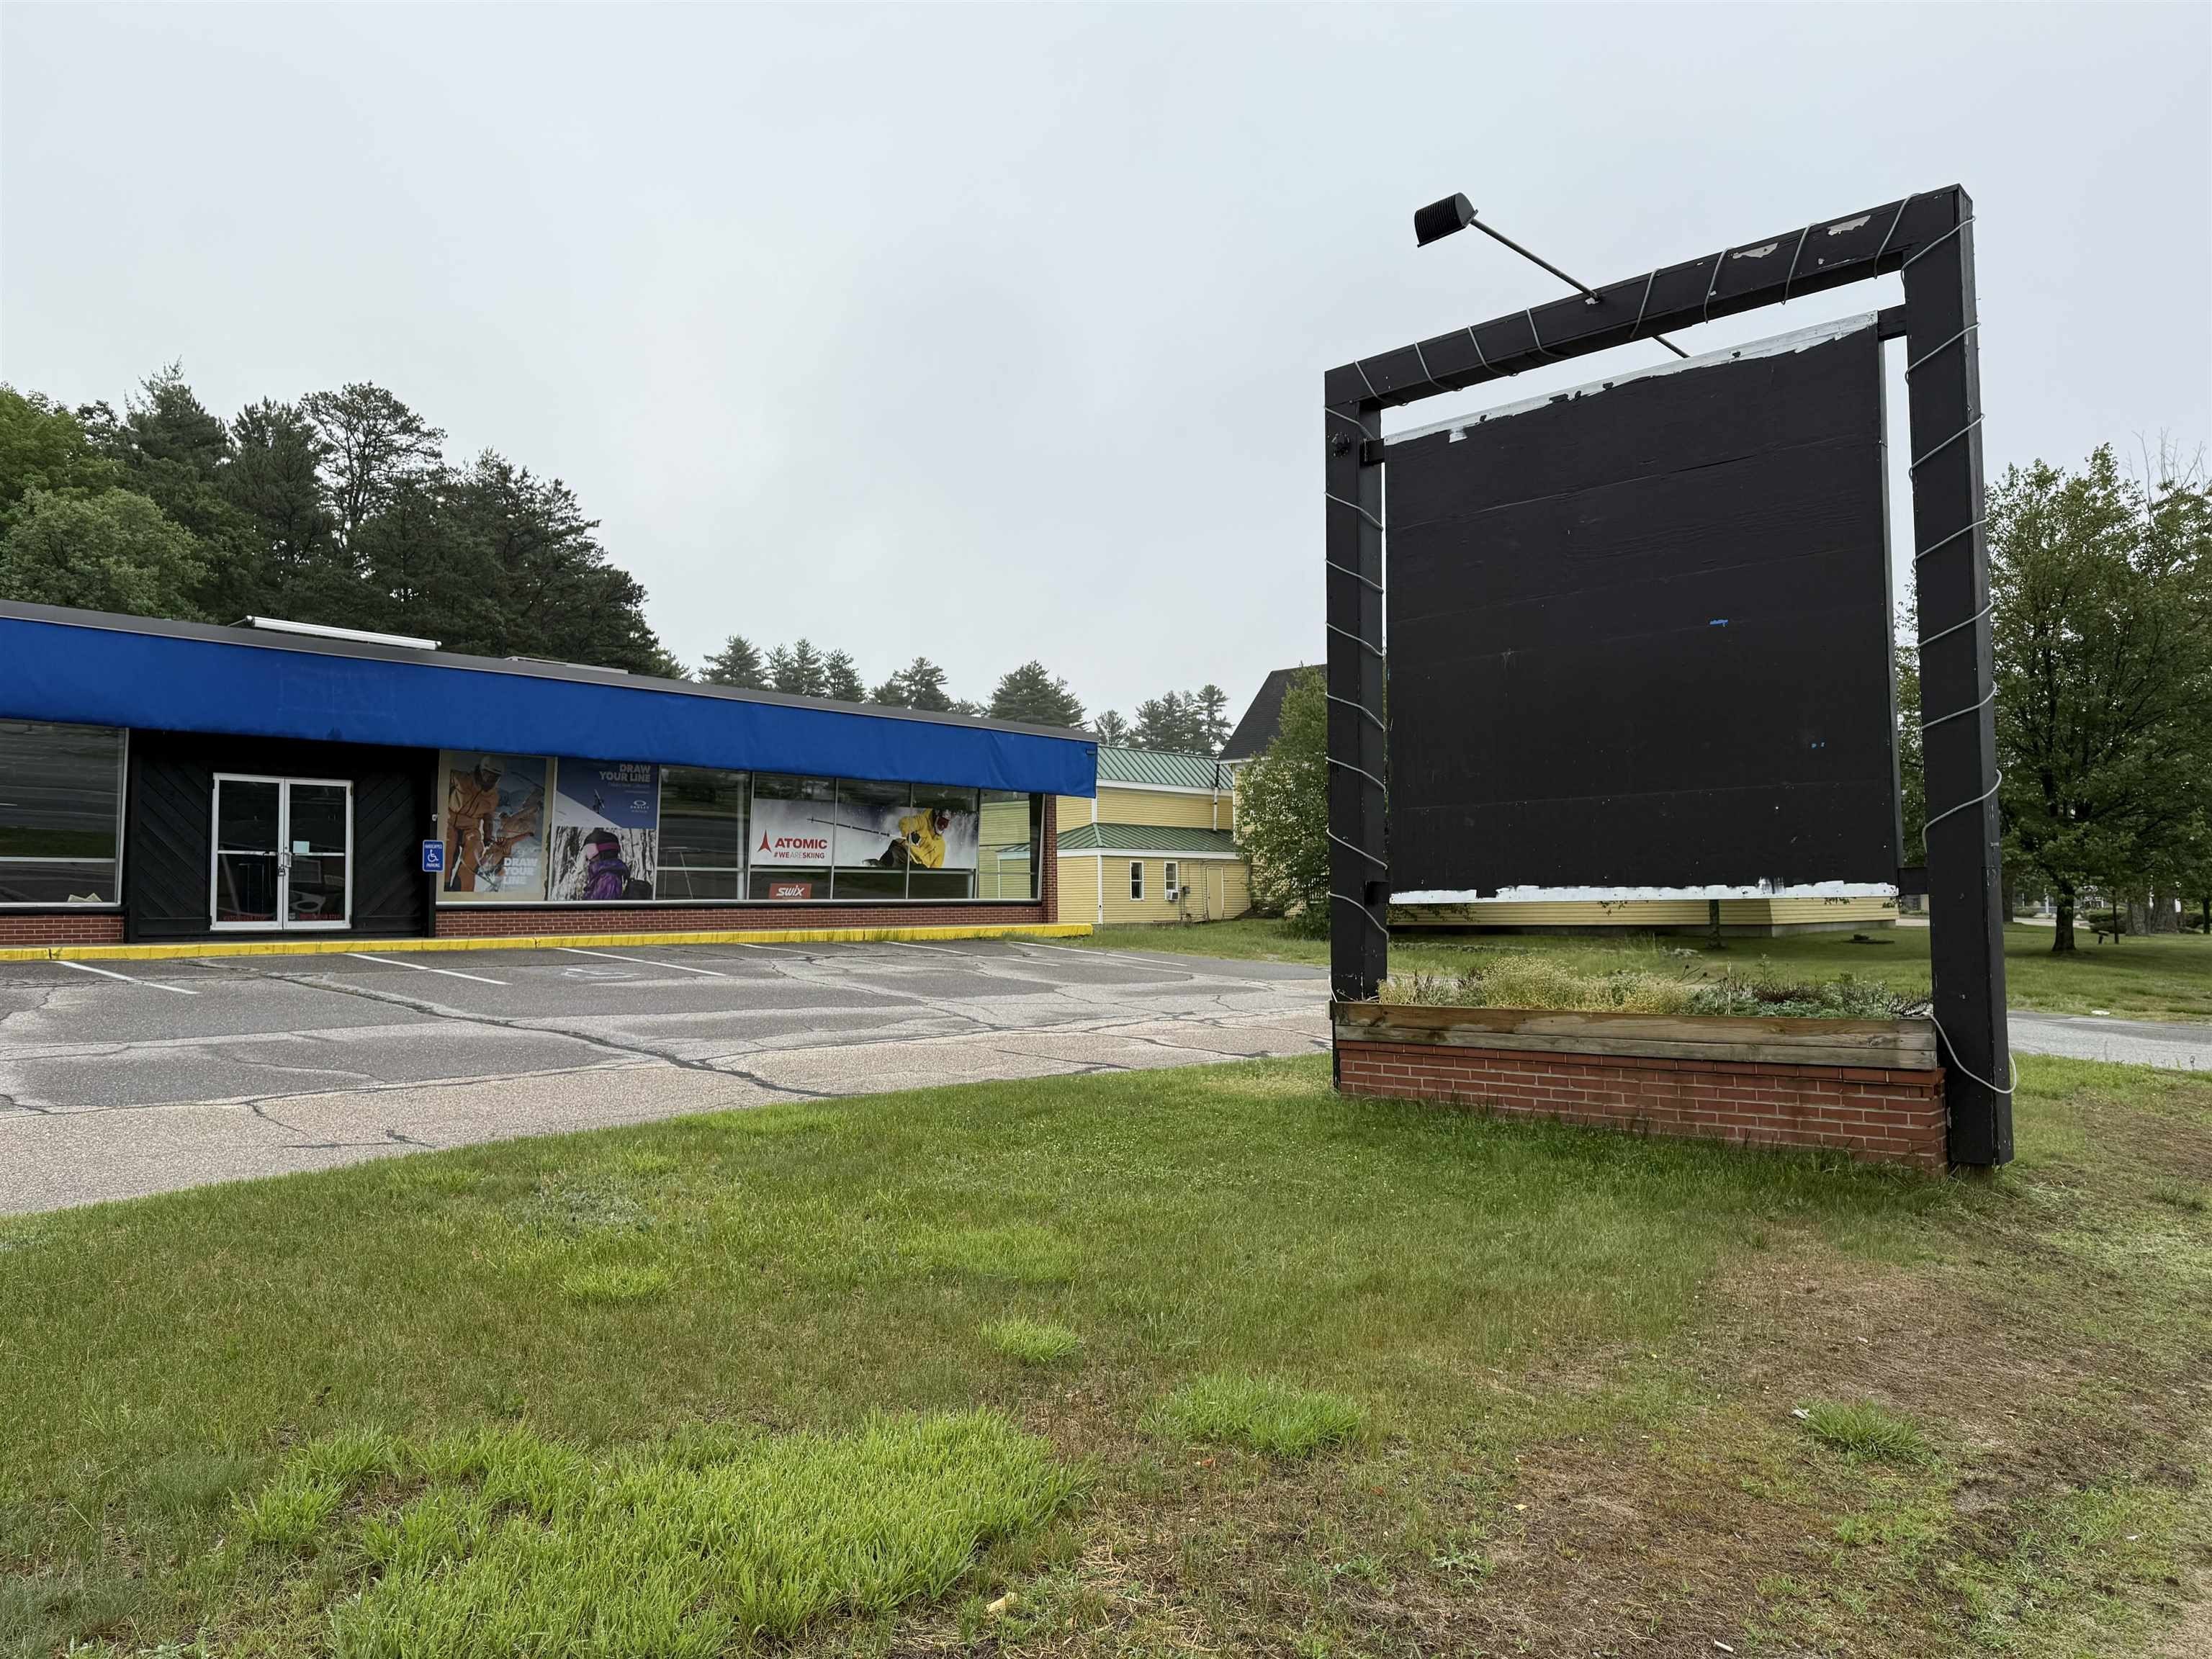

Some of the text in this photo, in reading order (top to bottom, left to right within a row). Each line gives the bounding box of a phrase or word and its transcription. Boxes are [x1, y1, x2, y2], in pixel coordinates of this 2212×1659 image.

[620, 764, 651, 773] DRAW
[599, 771, 651, 783] YOUR LINE
[775, 838, 827, 849] ATOMIC
[504, 858, 538, 866] DRAW
[503, 867, 534, 876] YOUR
